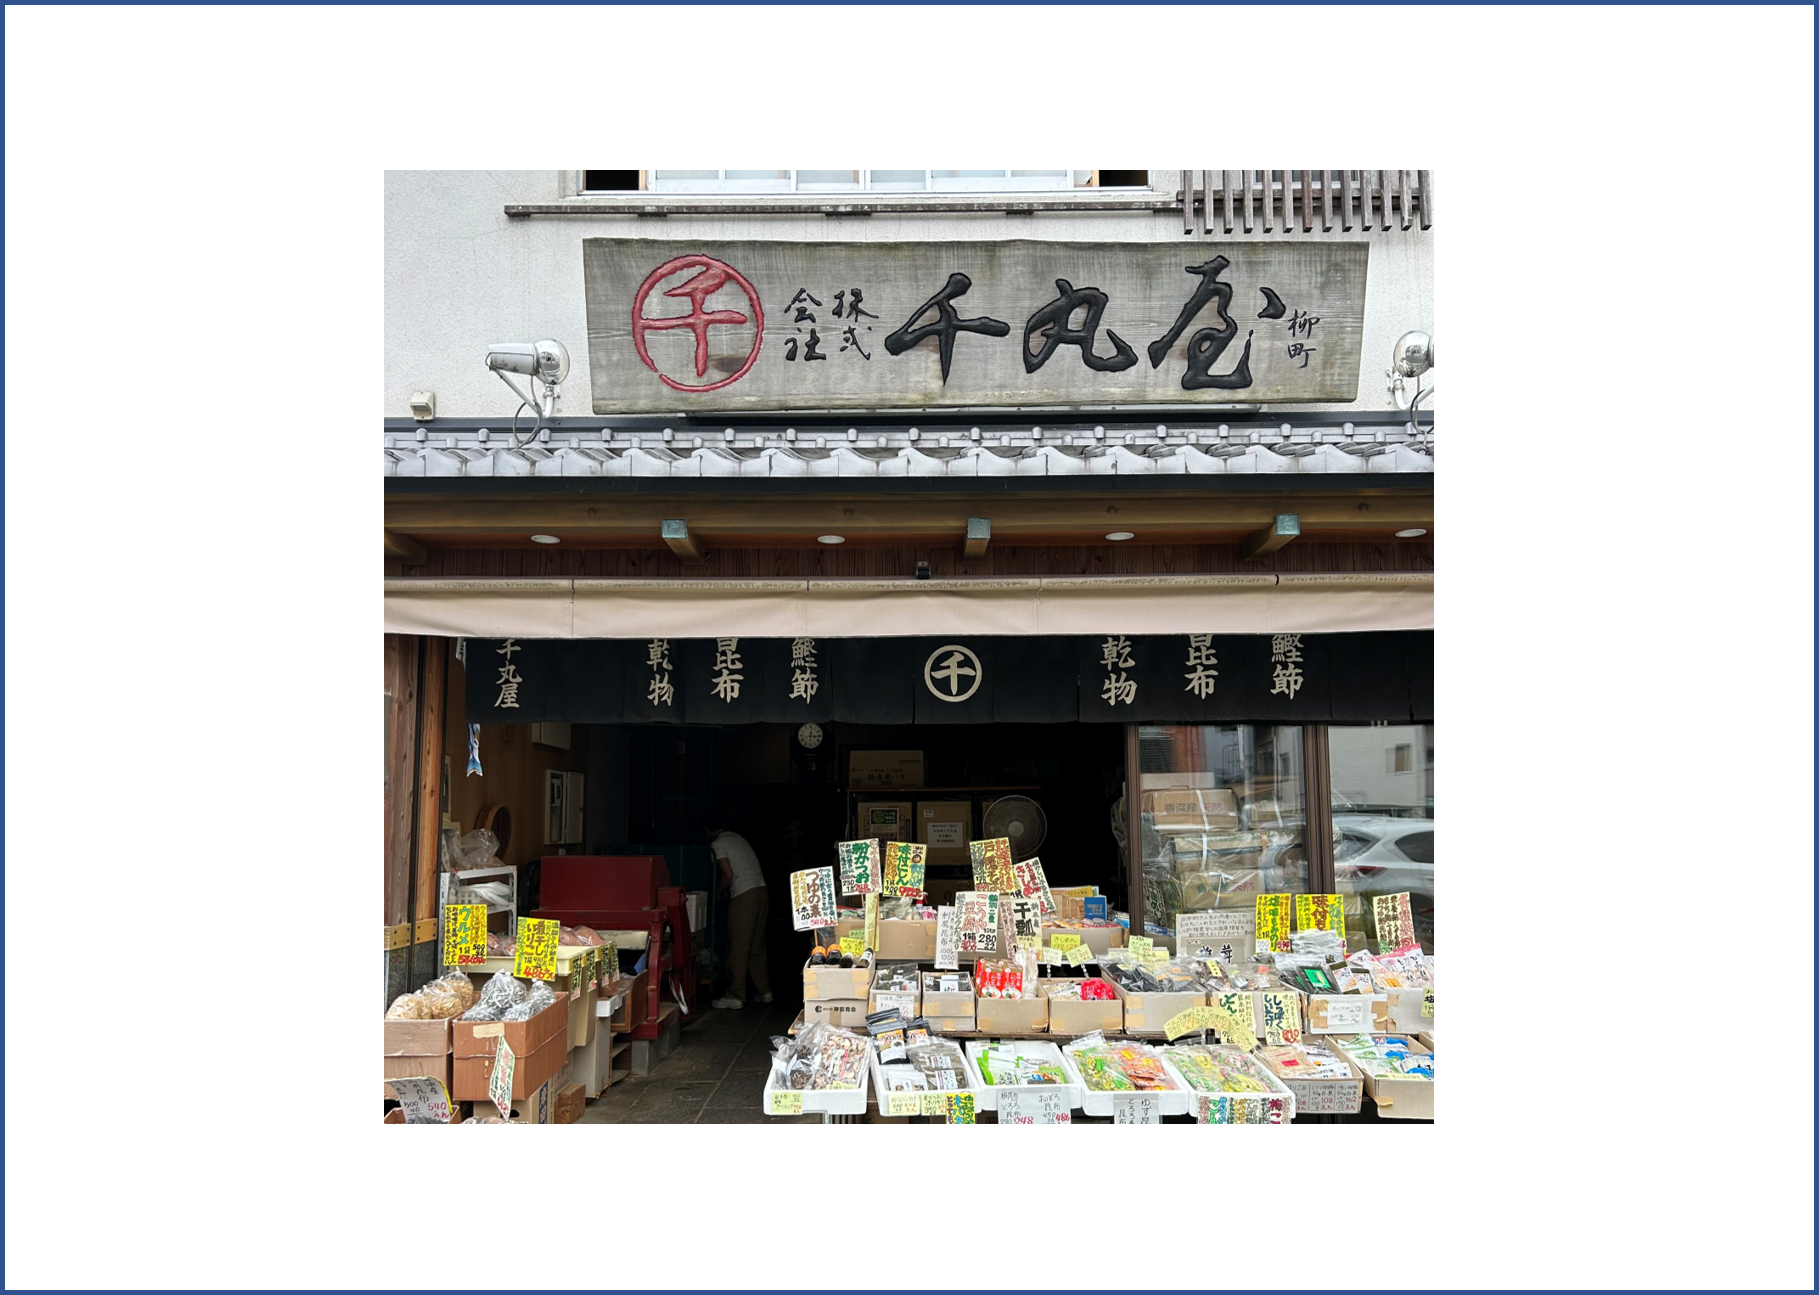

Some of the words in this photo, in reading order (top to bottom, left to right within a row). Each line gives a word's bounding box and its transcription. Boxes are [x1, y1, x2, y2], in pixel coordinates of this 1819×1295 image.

[884, 255, 1287, 391] 千丸屋
[1287, 308, 1321, 369] 柳町
[494, 638, 523, 709] 千丸屋
[645, 639, 674, 707] 乾物
[710, 637, 744, 703] 昆布
[788, 637, 820, 704] 鰹節
[929, 650, 978, 697] 千
[1101, 635, 1138, 706] 乾物
[1184, 634, 1219, 700] 昆布
[1270, 634, 1304, 700] 鰹節
[1203, 802, 1223, 813] 天然
[852, 842, 870, 884] 粉かつお
[805, 871, 821, 918] つゆの素
[1232, 881, 1255, 892] 天然
[457, 905, 471, 946] ウルメ
[961, 901, 977, 932] 豆腐
[976, 893, 988, 933] こうや
[978, 933, 997, 943] 280
[1264, 994, 1274, 1028] しいたけ
[428, 1102, 447, 1111] 540
[1001, 1102, 1021, 1111] とろろ
[1038, 1093, 1061, 1103] おぼろ
